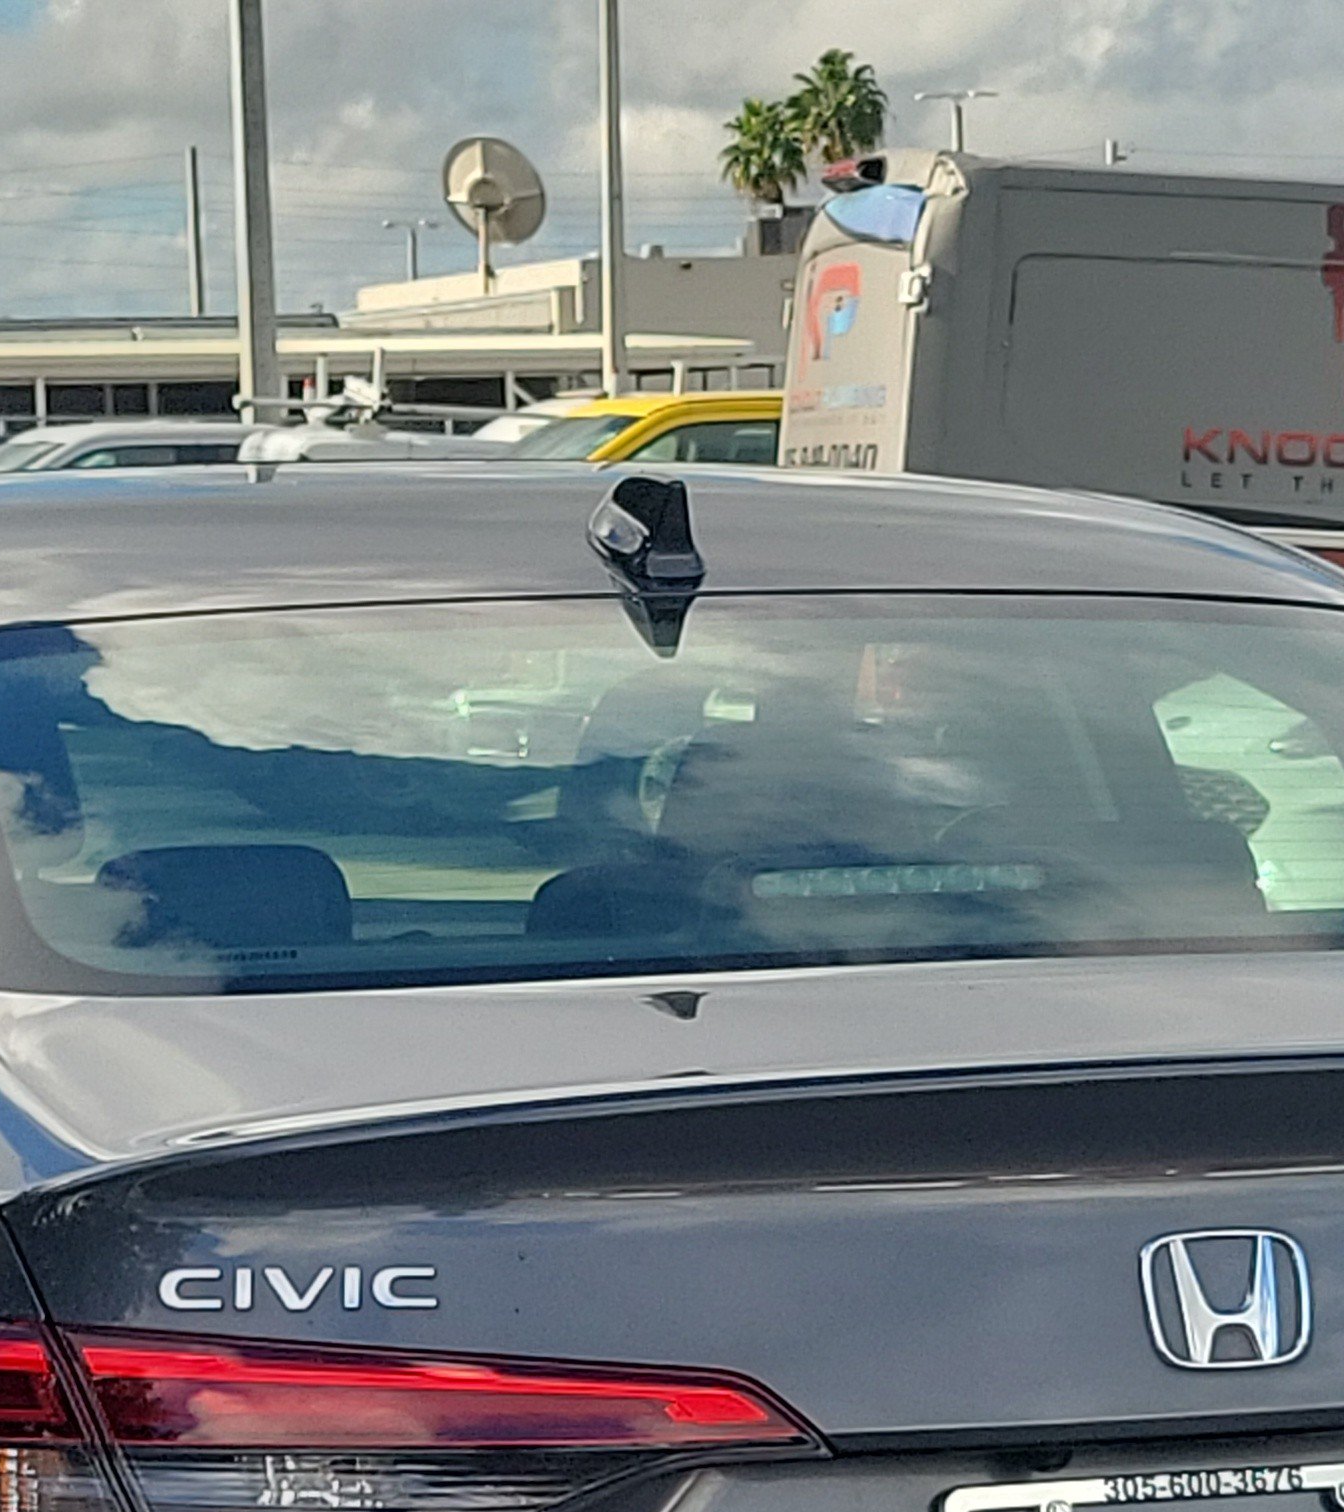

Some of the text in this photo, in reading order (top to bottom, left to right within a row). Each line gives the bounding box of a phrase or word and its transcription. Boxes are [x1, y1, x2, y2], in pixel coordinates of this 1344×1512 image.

[1181, 471, 1253, 489] LET
[158, 1266, 439, 1311] CIVIC
[1104, 1466, 1305, 1502] 305-600-3676
